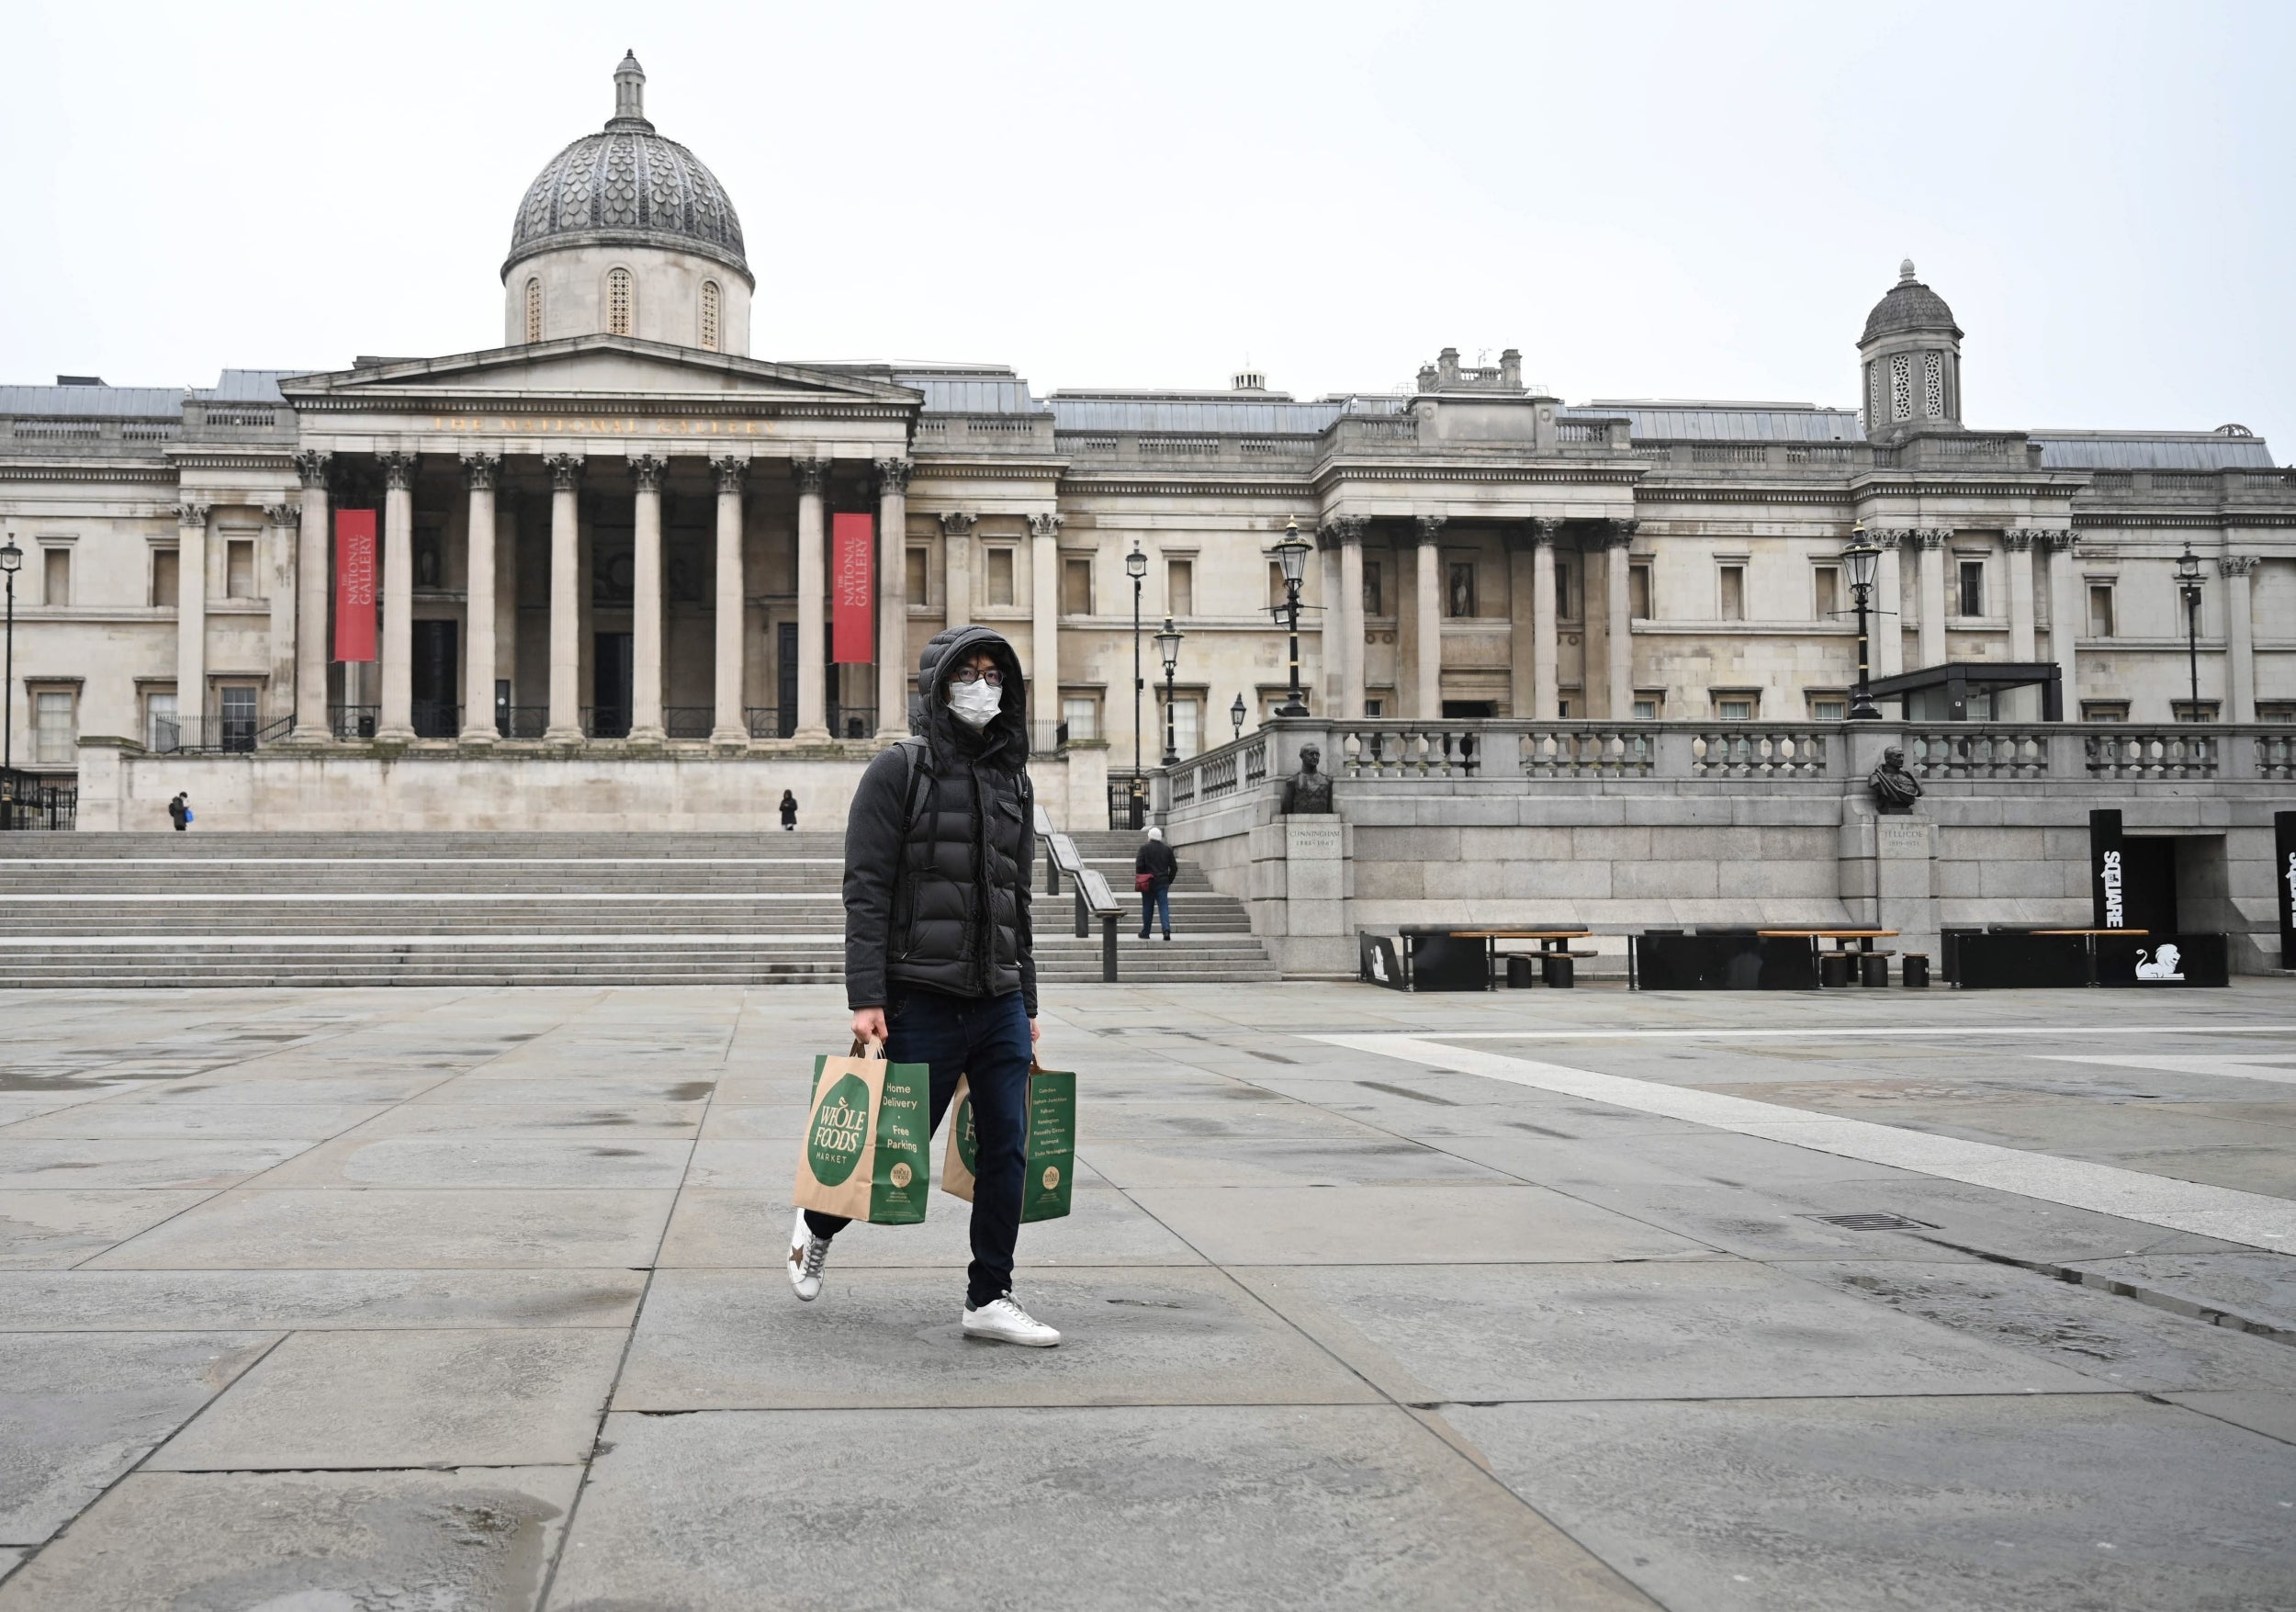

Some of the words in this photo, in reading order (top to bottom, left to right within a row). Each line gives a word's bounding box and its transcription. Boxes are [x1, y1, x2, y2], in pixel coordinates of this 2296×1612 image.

[434, 417, 485, 431] THE
[501, 418, 639, 434] NATIONAL
[657, 419, 777, 434] GALLERY
[348, 535, 359, 604] NATIONAL
[359, 535, 371, 605] GALLERY
[844, 537, 854, 606] NATIONAL
[855, 537, 867, 606] GALLERY
[2100, 851, 2123, 928] SQUARE
[886, 1082, 911, 1093] Home
[820, 1099, 866, 1131] WHOLE
[883, 1096, 917, 1110] Delivery
[814, 1126, 860, 1152] FOODS
[892, 1124, 909, 1136] Free
[816, 1152, 847, 1165] MARKET
[887, 1139, 917, 1154] Parking
